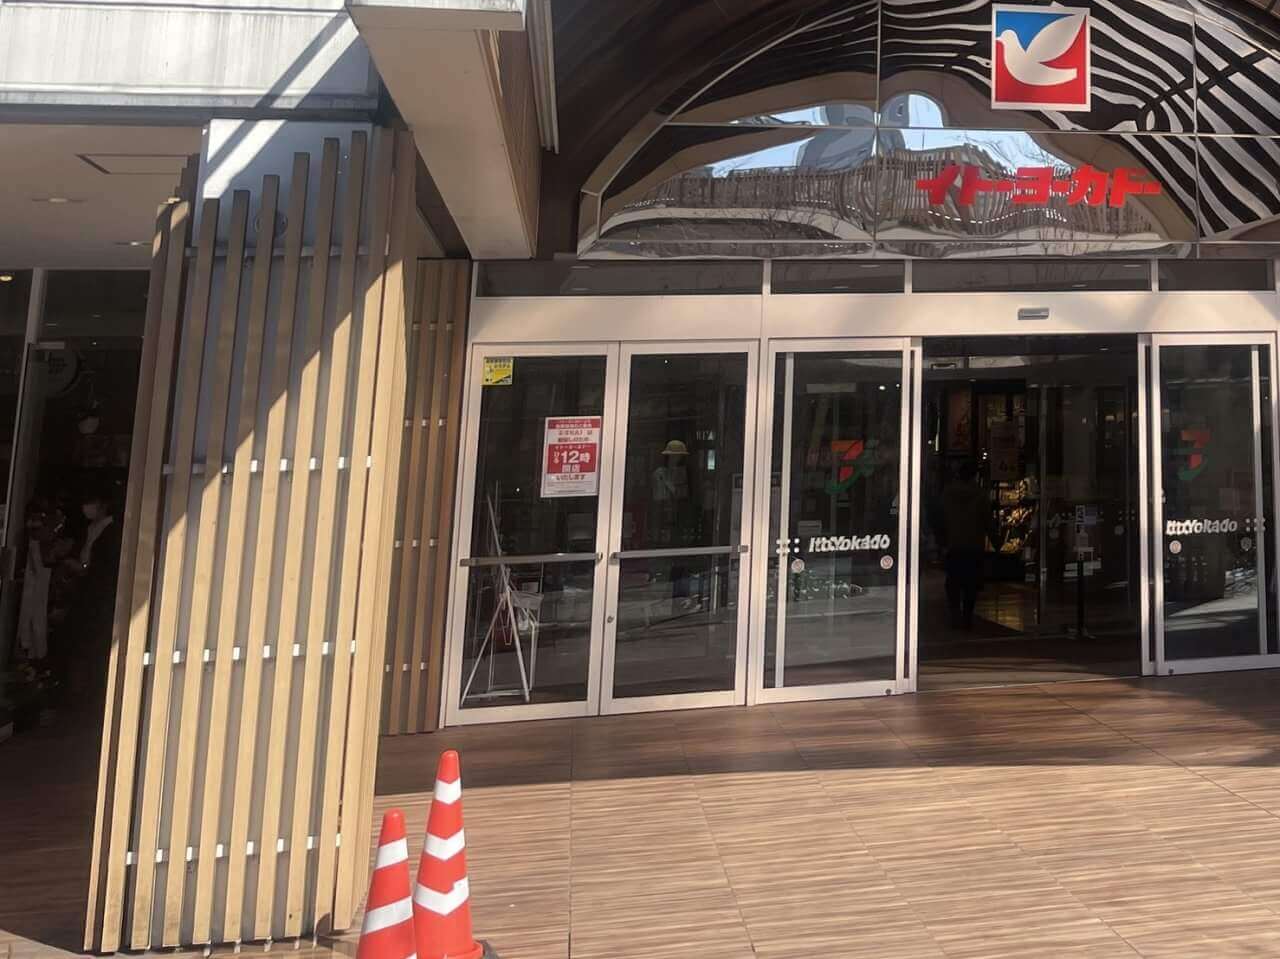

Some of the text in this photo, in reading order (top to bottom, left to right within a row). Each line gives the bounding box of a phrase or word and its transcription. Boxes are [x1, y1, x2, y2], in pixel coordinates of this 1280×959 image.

[916, 164, 1162, 208] イトーヨーカドー
